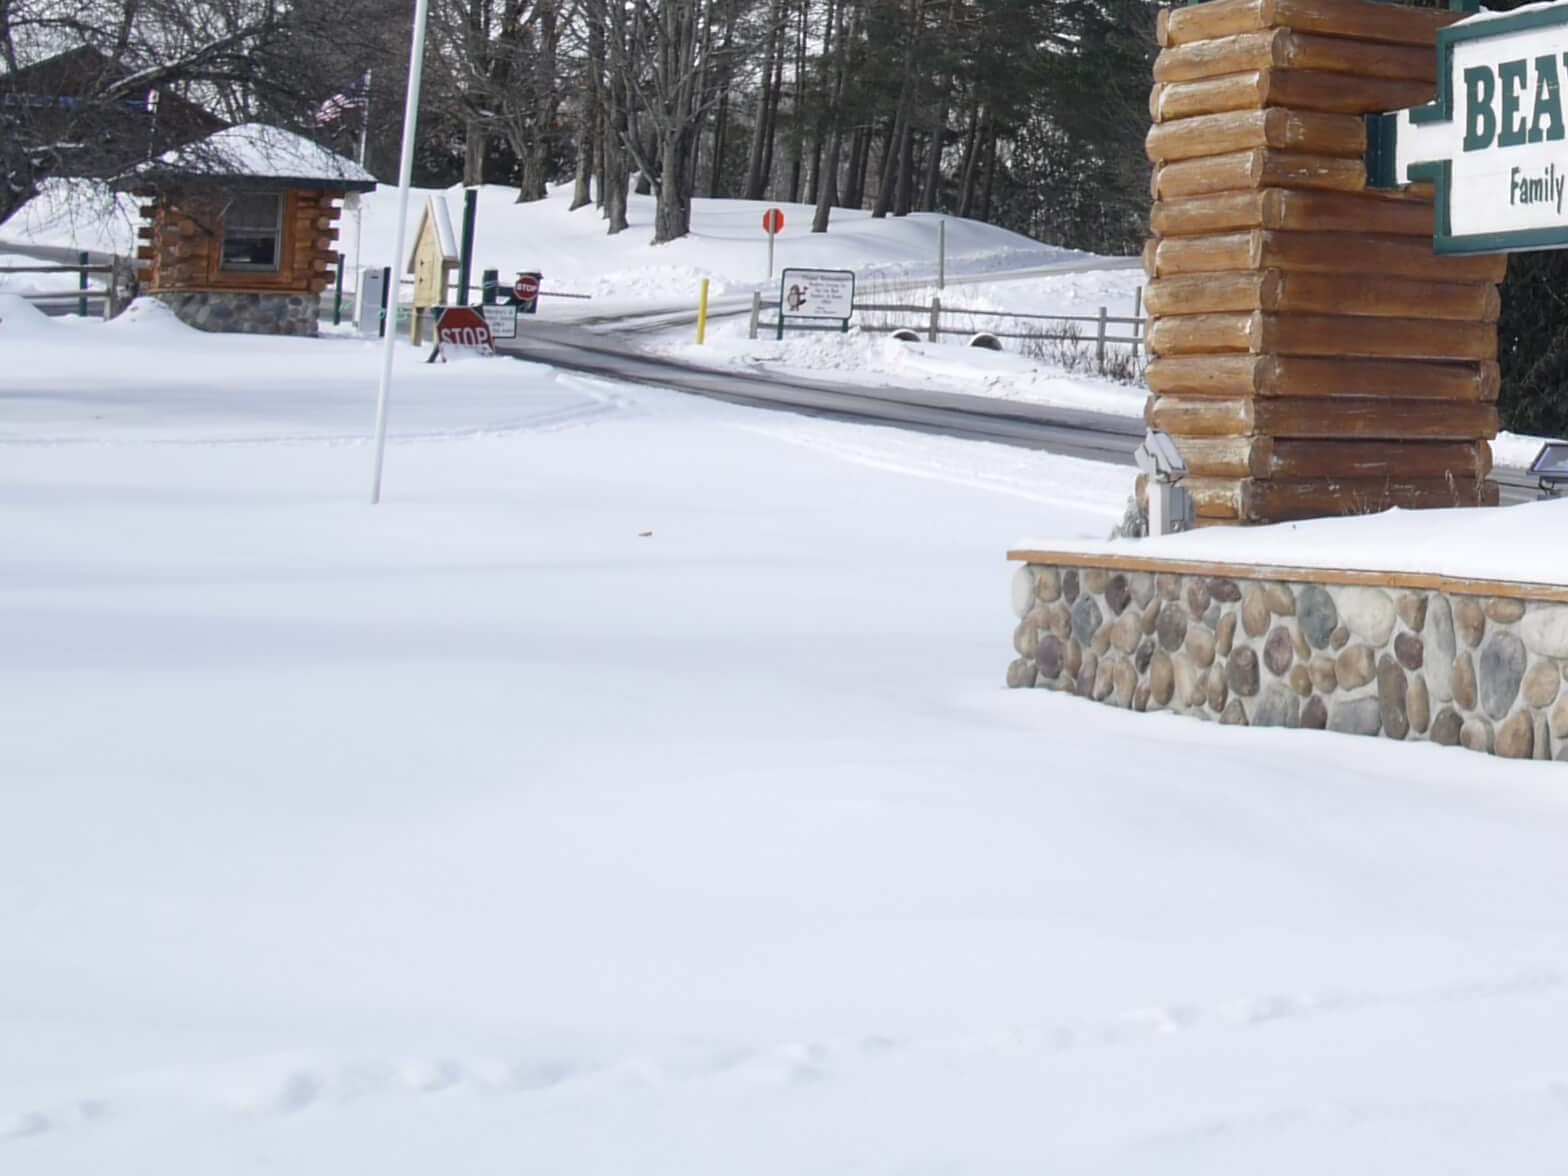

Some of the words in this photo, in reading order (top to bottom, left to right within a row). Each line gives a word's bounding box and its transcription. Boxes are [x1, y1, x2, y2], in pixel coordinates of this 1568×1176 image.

[1510, 162, 1565, 215] Family
[516, 283, 537, 293] STOP
[441, 326, 489, 348] STOP
